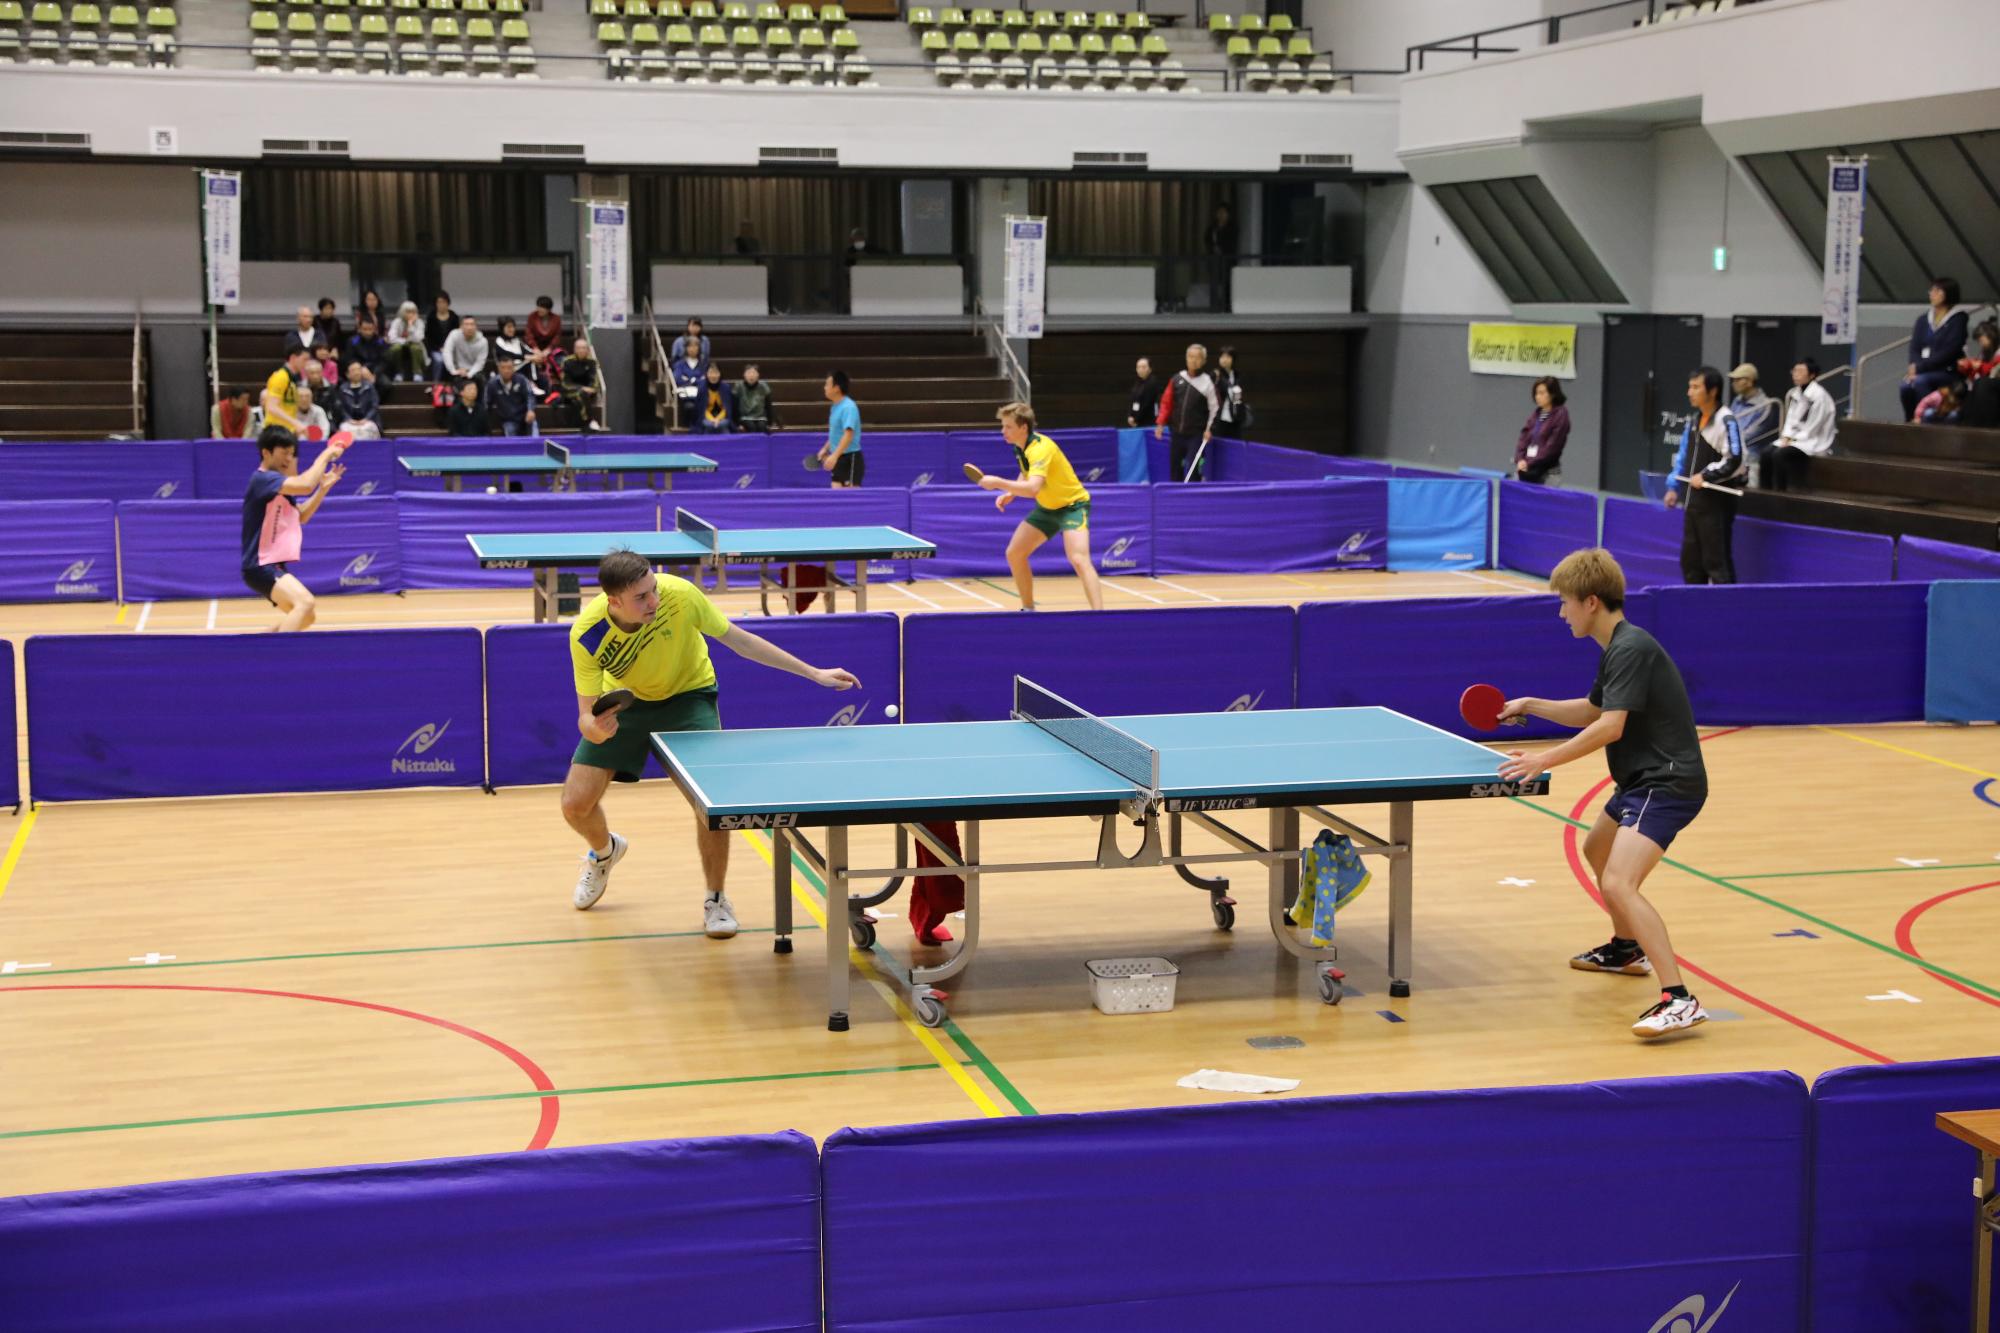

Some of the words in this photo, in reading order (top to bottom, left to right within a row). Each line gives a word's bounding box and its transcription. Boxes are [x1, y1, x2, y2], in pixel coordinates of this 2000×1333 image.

[1471, 338, 1505, 361] Welcome
[1517, 339, 1553, 364] Nishiwaki
[1552, 340, 1570, 371] City
[391, 757, 456, 774] Nittaku
[1470, 781, 1541, 798] SAN-EI
[718, 812, 799, 830] SAN-EI
